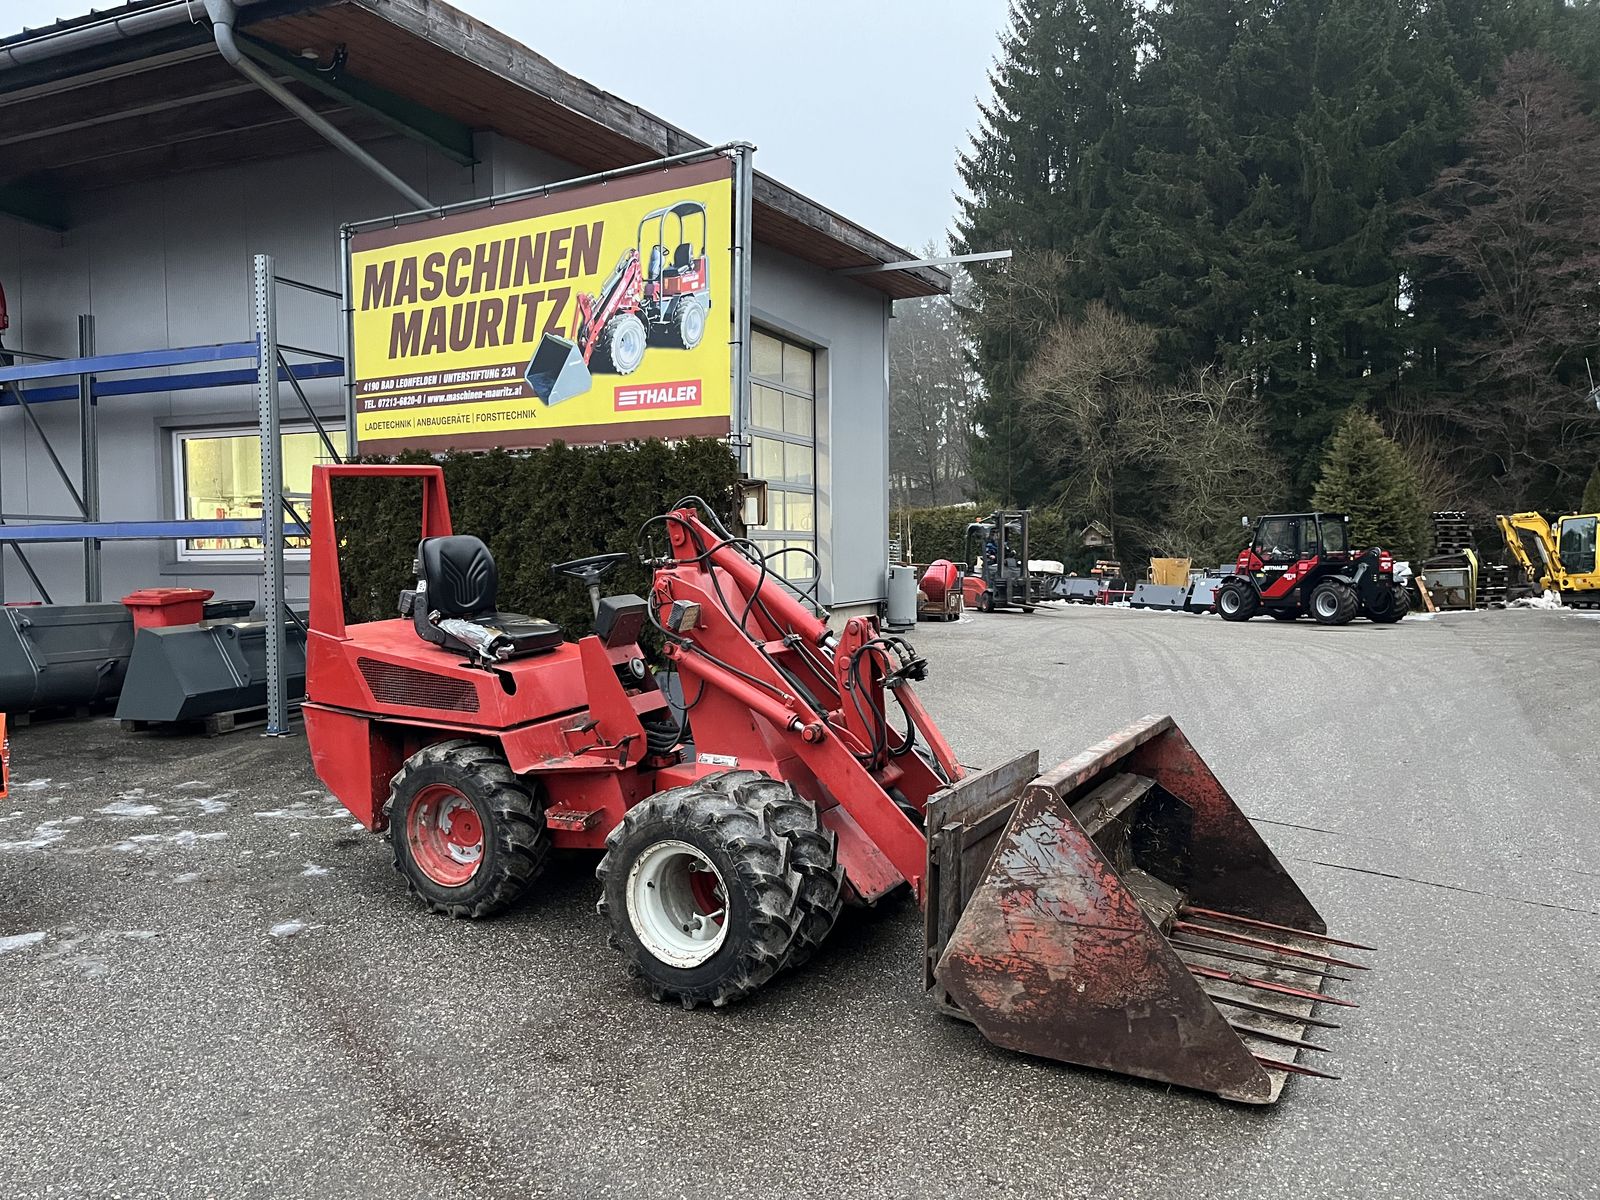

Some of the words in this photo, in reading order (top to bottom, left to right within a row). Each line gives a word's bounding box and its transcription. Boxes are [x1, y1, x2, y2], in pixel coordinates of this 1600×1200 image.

[361, 220, 605, 311] MASCHINEN
[388, 286, 571, 360] MAURITZ
[363, 381, 380, 392] 4190
[381, 379, 395, 390] BAD
[395, 374, 438, 389] LEONFELDEN
[443, 368, 500, 383] UNTERSTIFTUNG
[501, 366, 516, 378] 23A
[364, 400, 376, 410] TEL.
[427, 385, 523, 404] www.maschinen-mauritz.at
[637, 385, 697, 405] THALER
[364, 419, 412, 431] LADETECHNIK
[416, 413, 471, 426] ANBAUGERÄTE
[476, 409, 537, 422] FORSTTECHNIK
